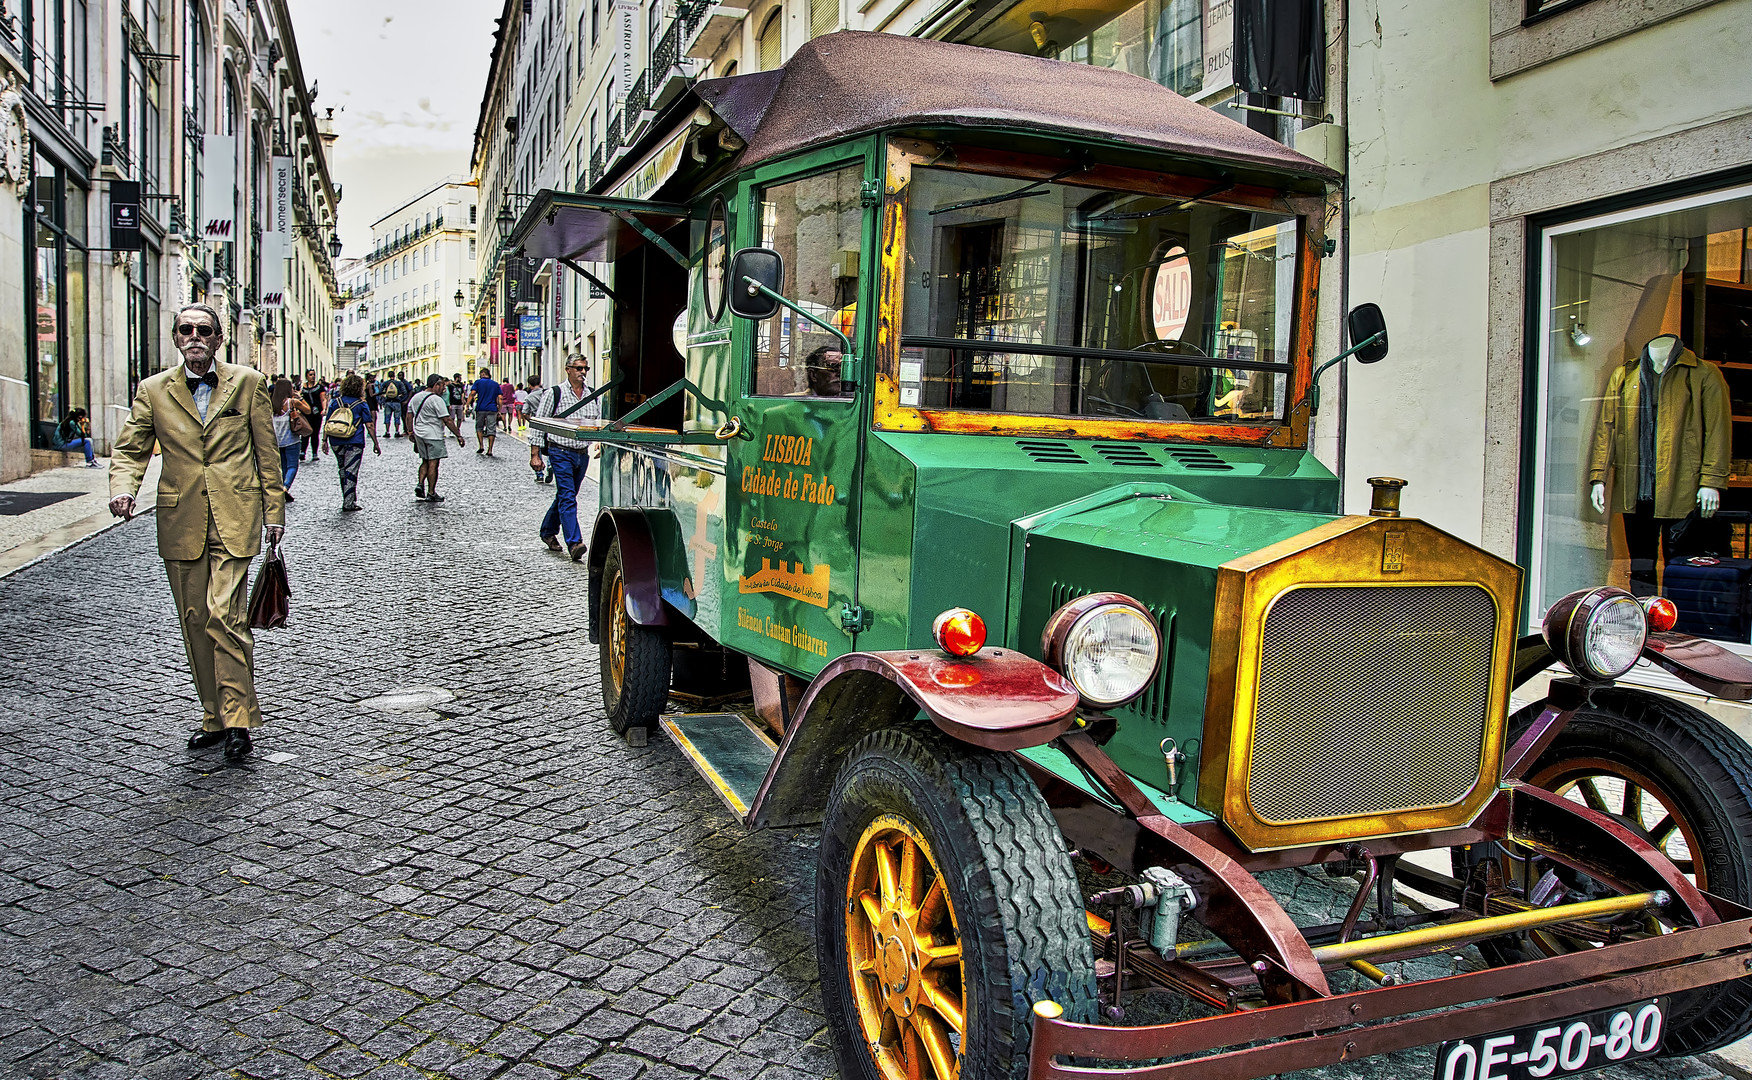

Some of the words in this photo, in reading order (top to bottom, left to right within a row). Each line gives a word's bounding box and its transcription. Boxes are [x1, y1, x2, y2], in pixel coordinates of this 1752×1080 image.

[624, 52, 631, 60] &
[624, 62, 632, 91] ALVIM
[205, 219, 231, 236] H&M
[263, 292, 282, 305] H&M
[763, 434, 813, 466] LISBOA
[741, 465, 781, 497] Cidade
[783, 471, 799, 500] de
[800, 473, 835, 506] Fado
[751, 516, 778, 531] Castelo
[745, 530, 753, 542] de
[754, 534, 761, 545] S.
[762, 536, 784, 553] Jorge
[770, 577, 793, 592] Cidade
[793, 582, 801, 594] de
[802, 585, 823, 600] Lisboa
[765, 615, 791, 645] Cantam
[792, 624, 828, 658] Guitarras
